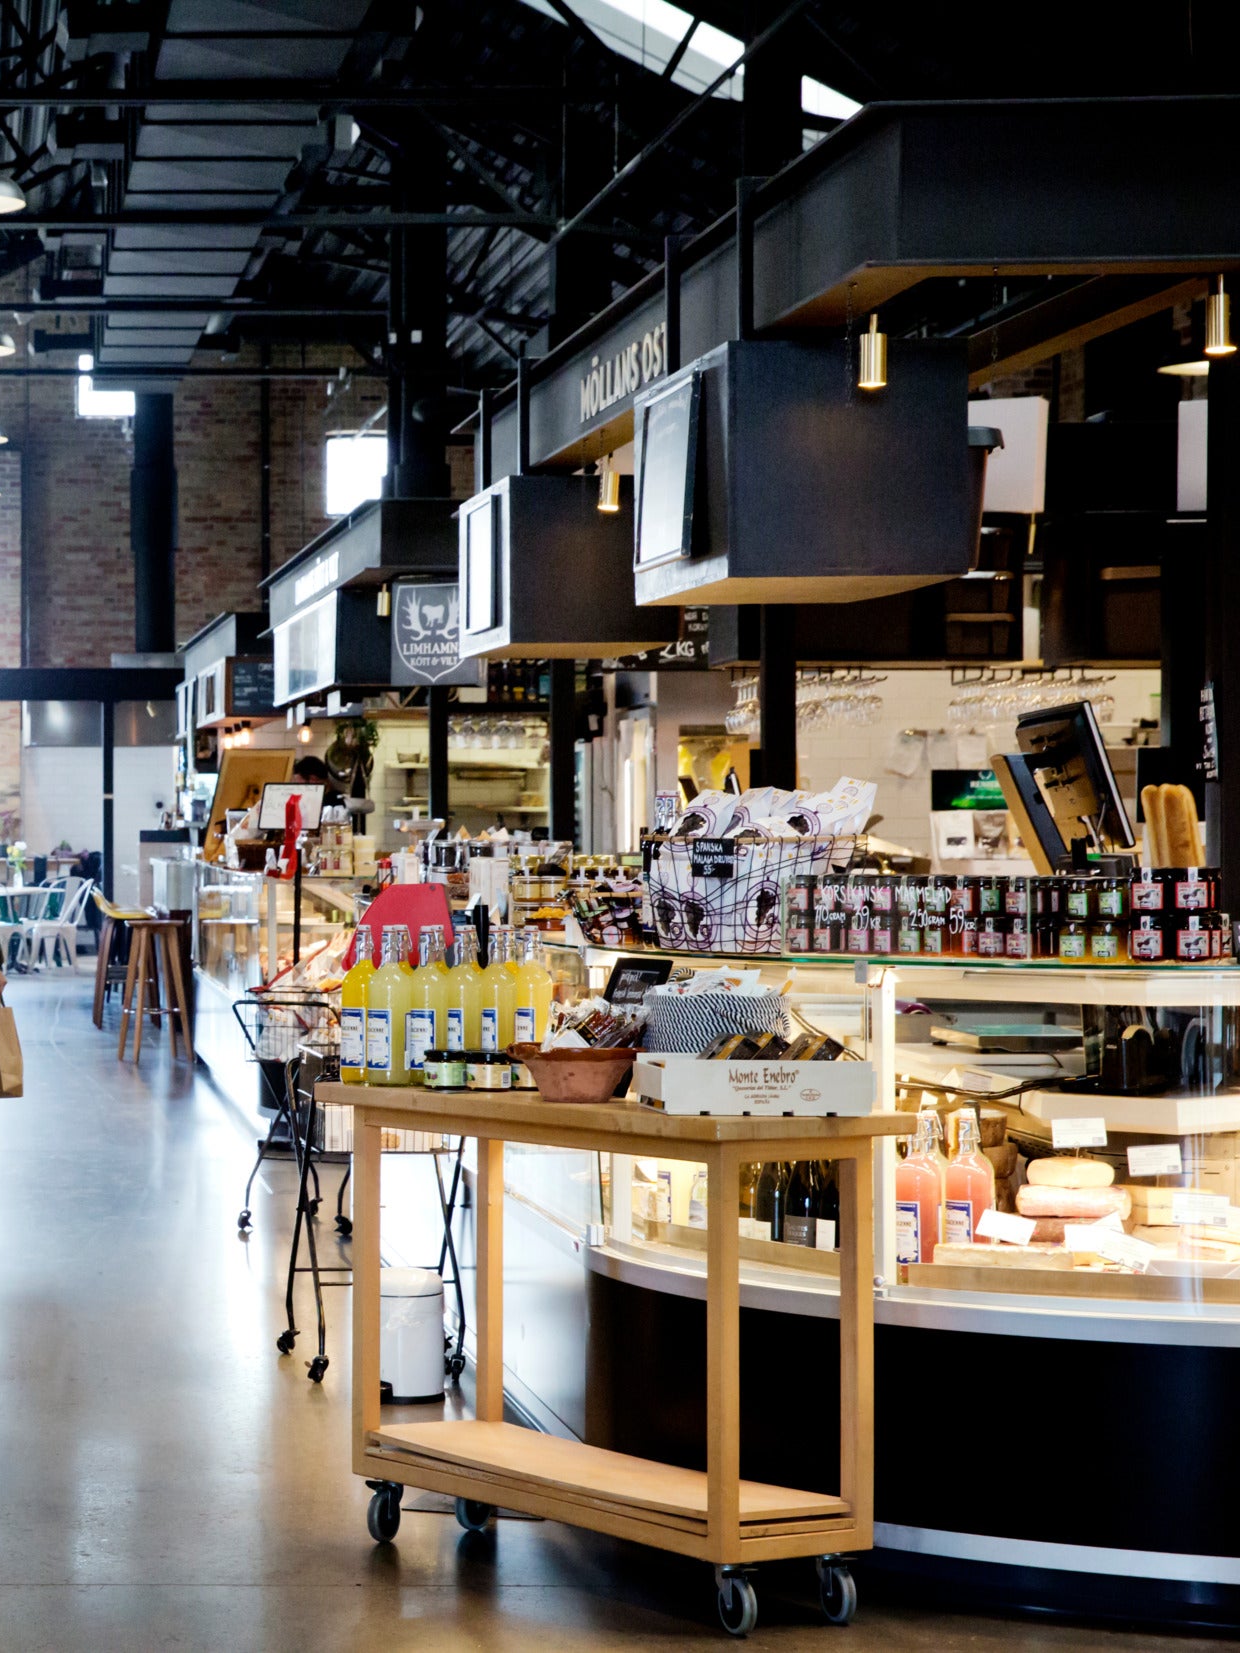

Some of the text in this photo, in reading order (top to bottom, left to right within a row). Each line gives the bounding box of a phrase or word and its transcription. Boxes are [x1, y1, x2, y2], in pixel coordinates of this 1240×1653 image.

[580, 342, 639, 423] MÖLLANS
[410, 656, 430, 666] KÖTT
[440, 656, 458, 665] VILT
[696, 842, 723, 853] SPANSKA
[821, 885, 952, 904] KORSIKANSK MARMELAD
[829, 911, 846, 922] GRAM
[855, 905, 870, 931] 39
[870, 917, 882, 930] KR
[910, 909, 928, 927] 250
[928, 915, 946, 926] GRAM
[949, 907, 965, 934] 59
[964, 920, 976, 931] KR
[728, 1068, 759, 1084] Monte
